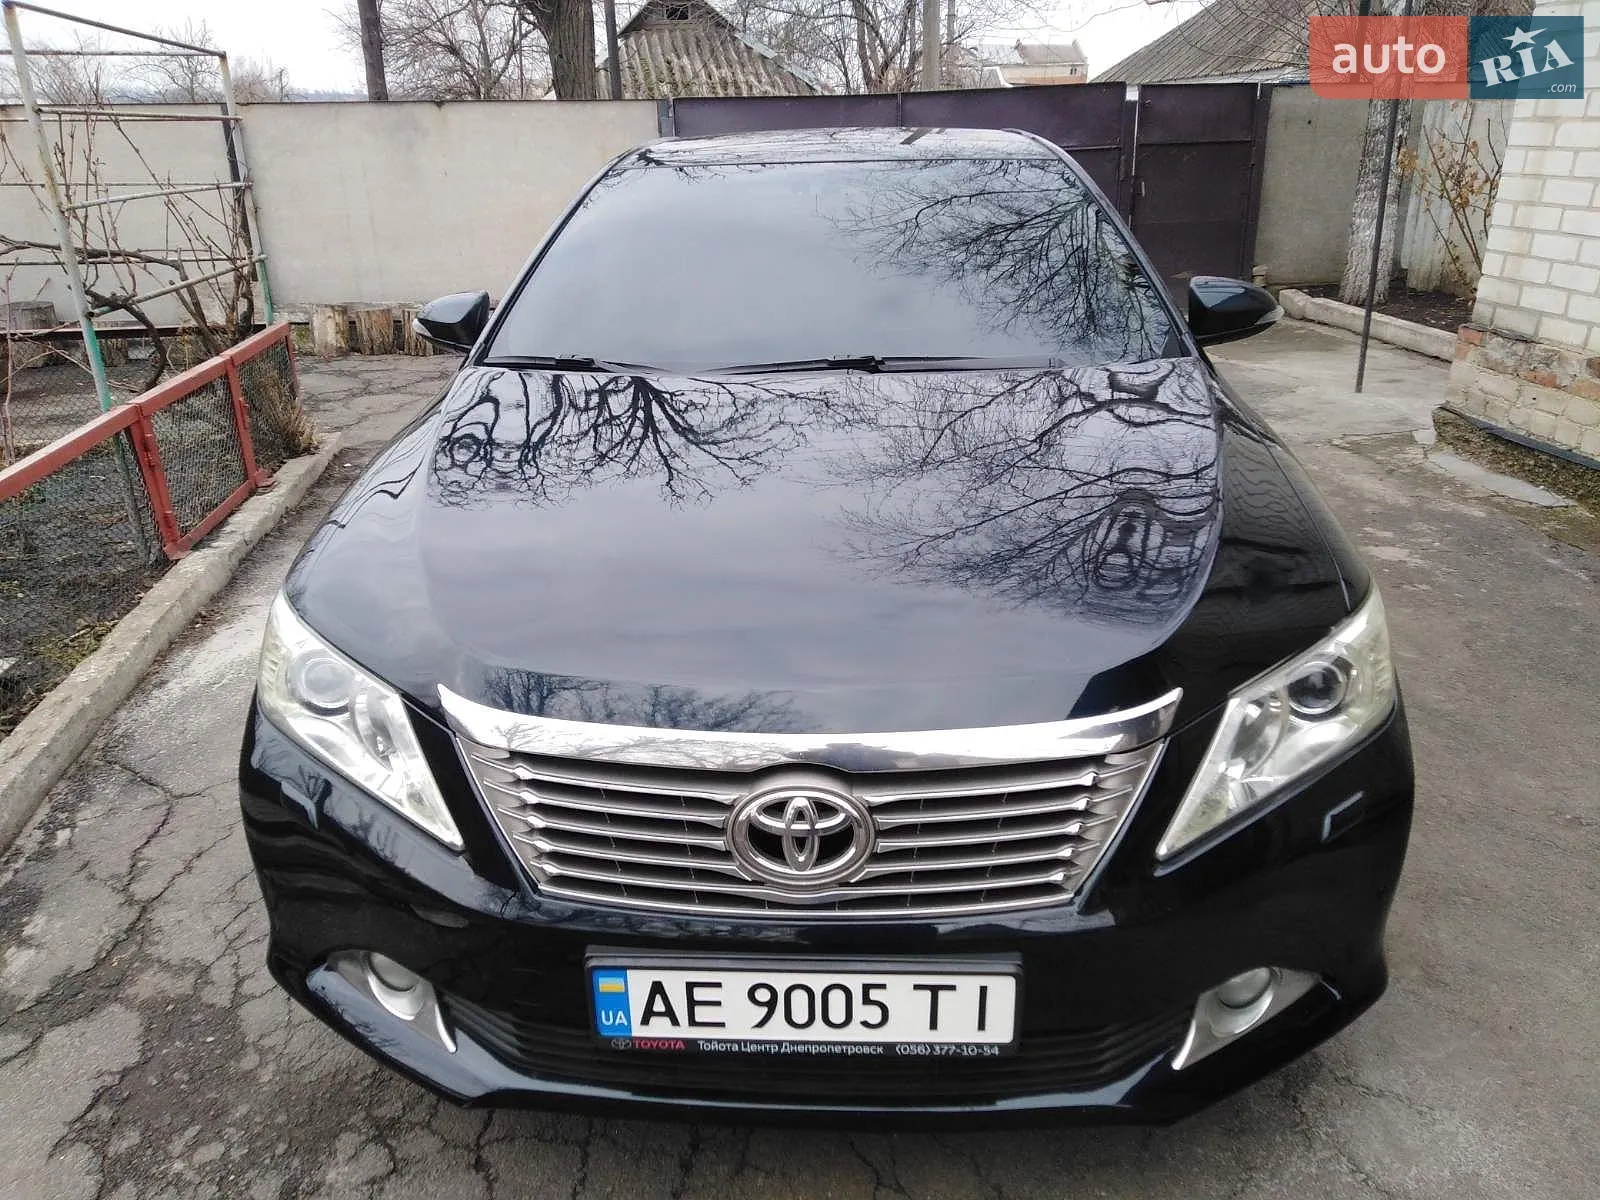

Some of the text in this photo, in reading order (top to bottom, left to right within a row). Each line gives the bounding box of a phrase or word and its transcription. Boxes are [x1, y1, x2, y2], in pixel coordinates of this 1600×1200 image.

[639, 980, 988, 1032] AE 9005 TI
[601, 1009, 628, 1027] UA
[632, 1039, 686, 1050] TOYOTA
[698, 1040, 885, 1056] Тойота Центр Днепропетровск
